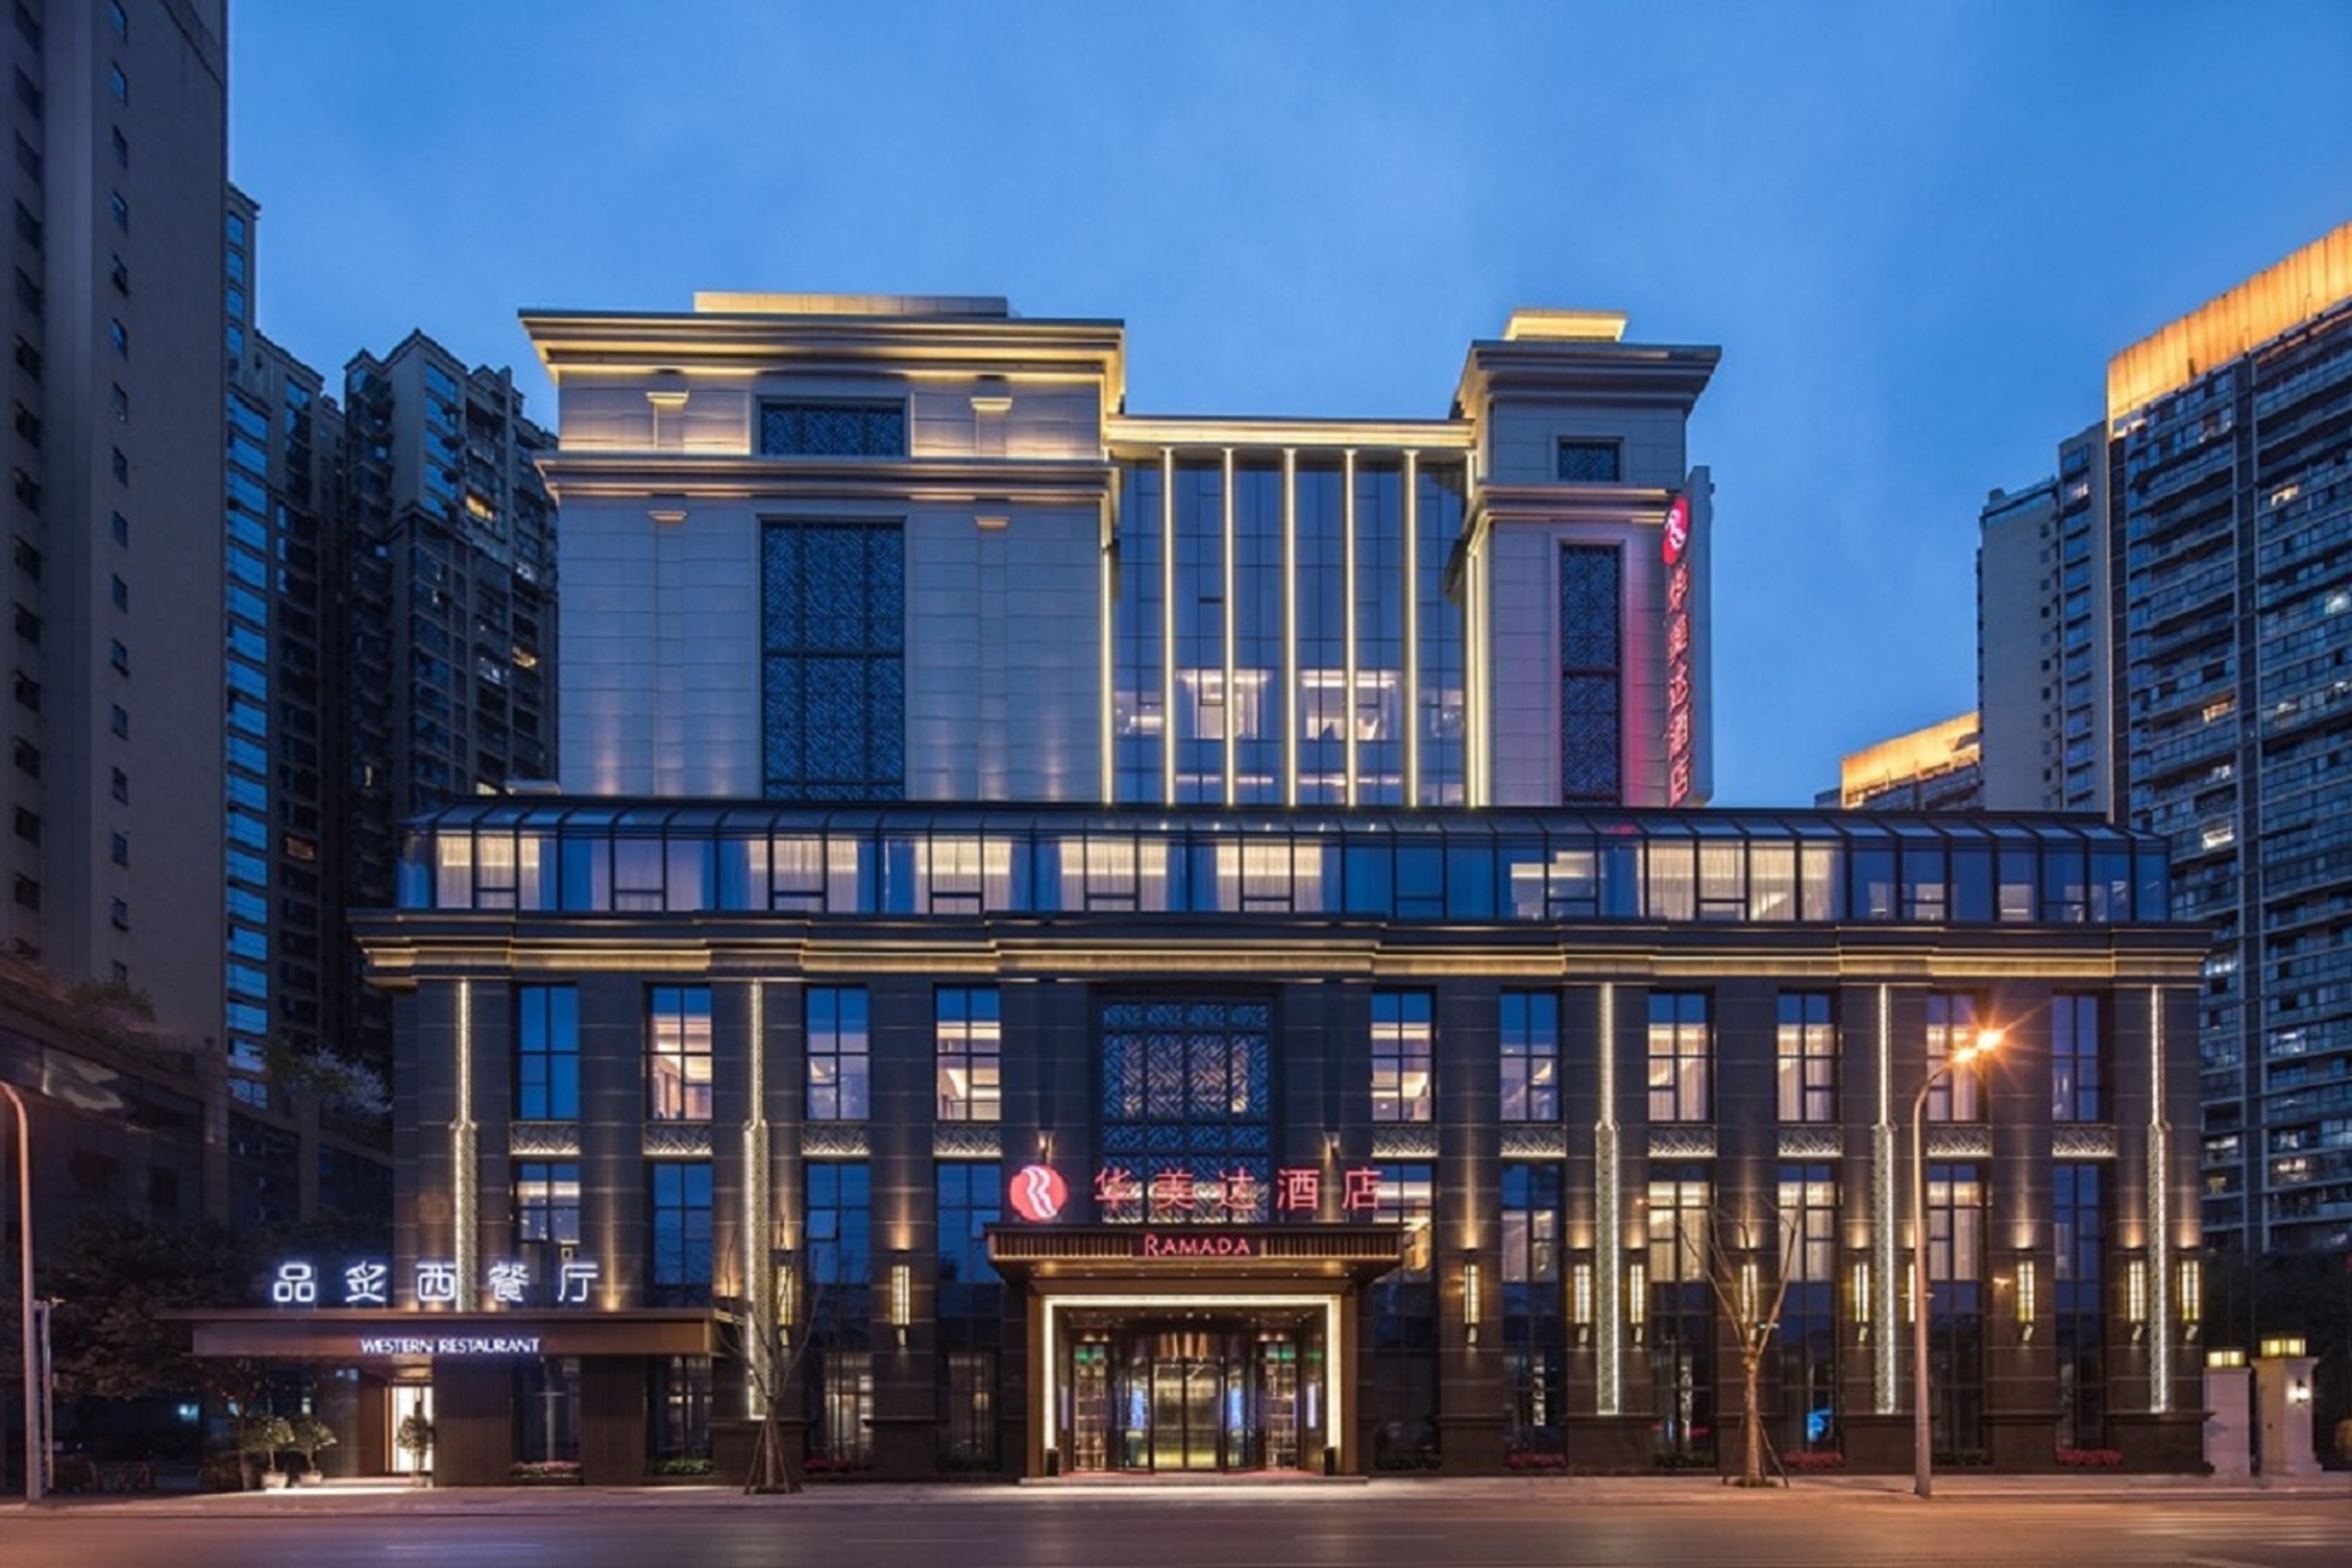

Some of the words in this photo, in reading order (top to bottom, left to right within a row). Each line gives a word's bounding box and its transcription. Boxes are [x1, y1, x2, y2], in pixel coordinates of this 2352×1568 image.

[1094, 1166, 1382, 1210] 华美达酒店
[1145, 1233, 1250, 1257] RAMADA
[274, 1261, 598, 1302] 品炙西餐厅
[361, 1338, 432, 1354] WESTERN
[437, 1338, 539, 1354] RESTAURANT
